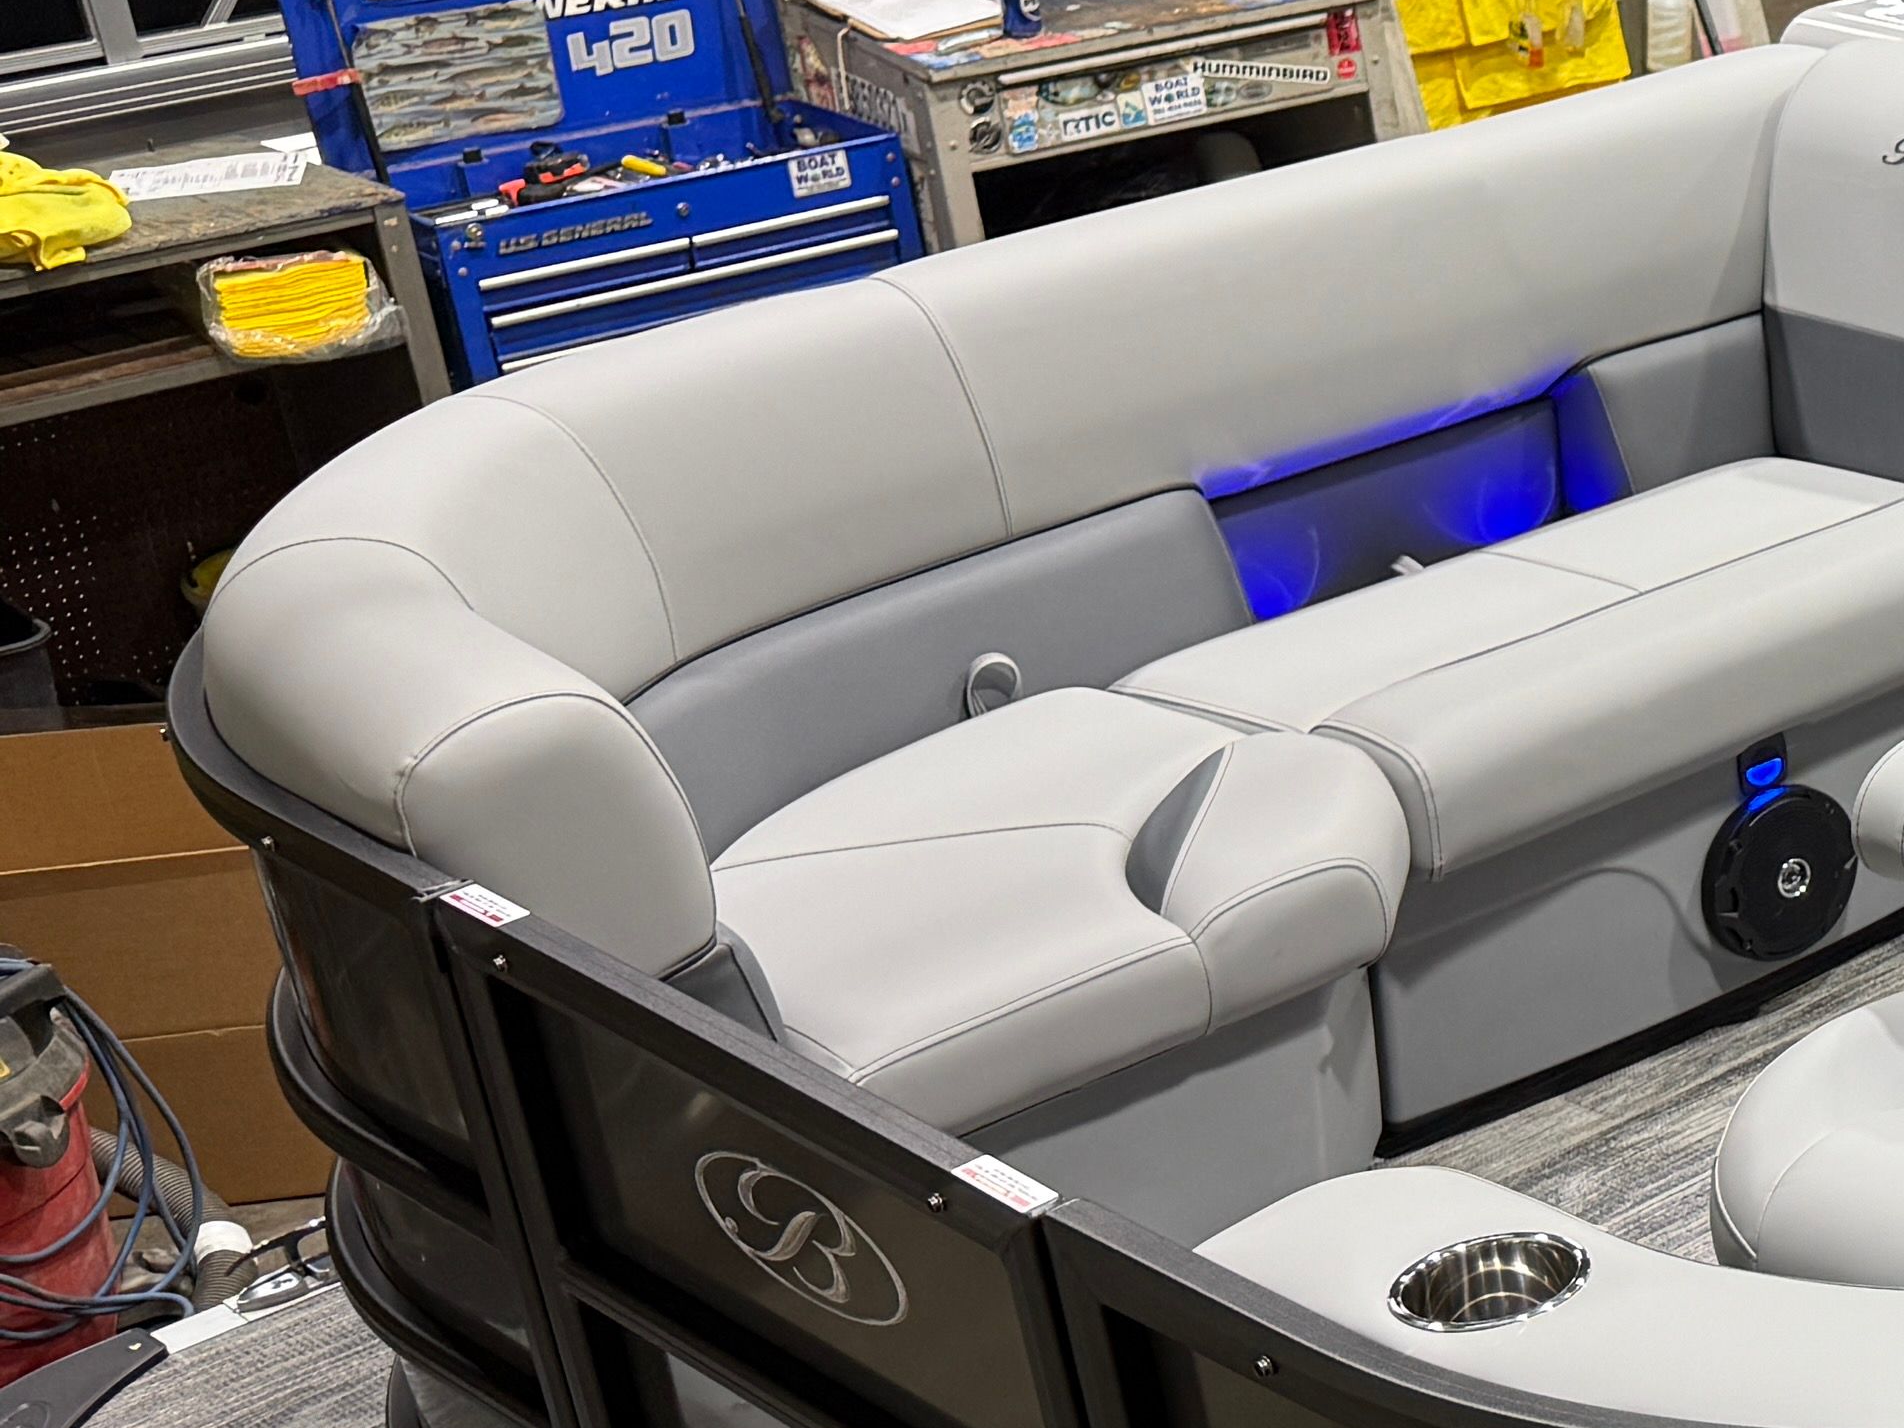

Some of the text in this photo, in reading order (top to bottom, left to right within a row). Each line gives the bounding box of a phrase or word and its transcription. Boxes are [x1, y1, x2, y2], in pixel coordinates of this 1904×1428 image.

[566, 8, 695, 77] 420
[1154, 75, 1189, 93] BOAT
[796, 152, 837, 172] BOAT
